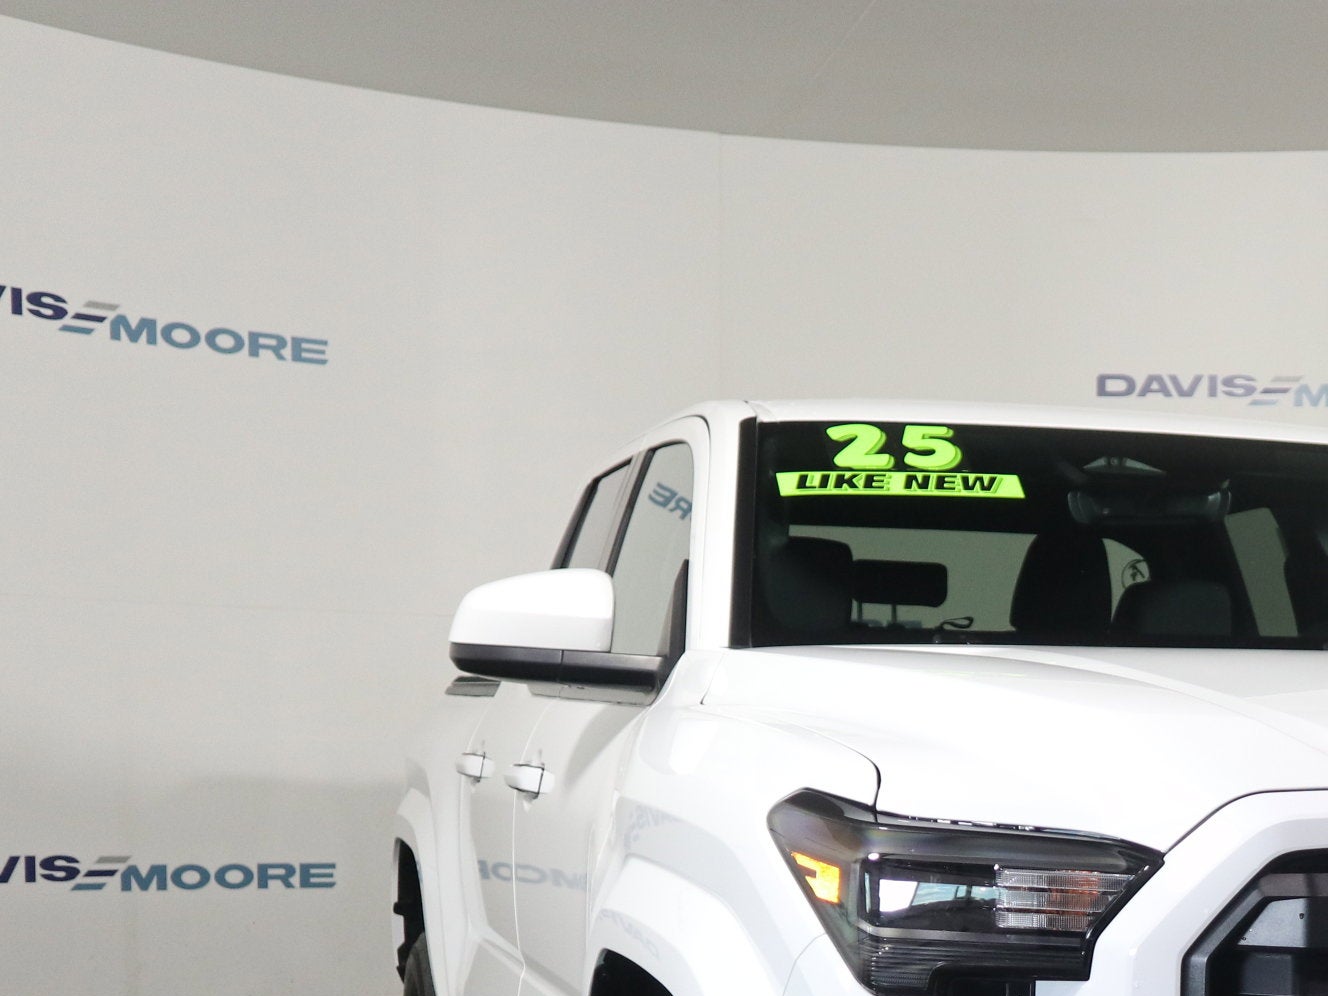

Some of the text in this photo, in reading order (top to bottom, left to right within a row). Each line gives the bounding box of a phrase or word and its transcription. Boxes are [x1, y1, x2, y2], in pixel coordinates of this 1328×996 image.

[0, 285, 329, 366] IS MOORE
[1096, 373, 1256, 398] DAVIS
[826, 423, 963, 471] 25
[795, 473, 1003, 494] LIKE NEW
[121, 863, 337, 892] MOORE
